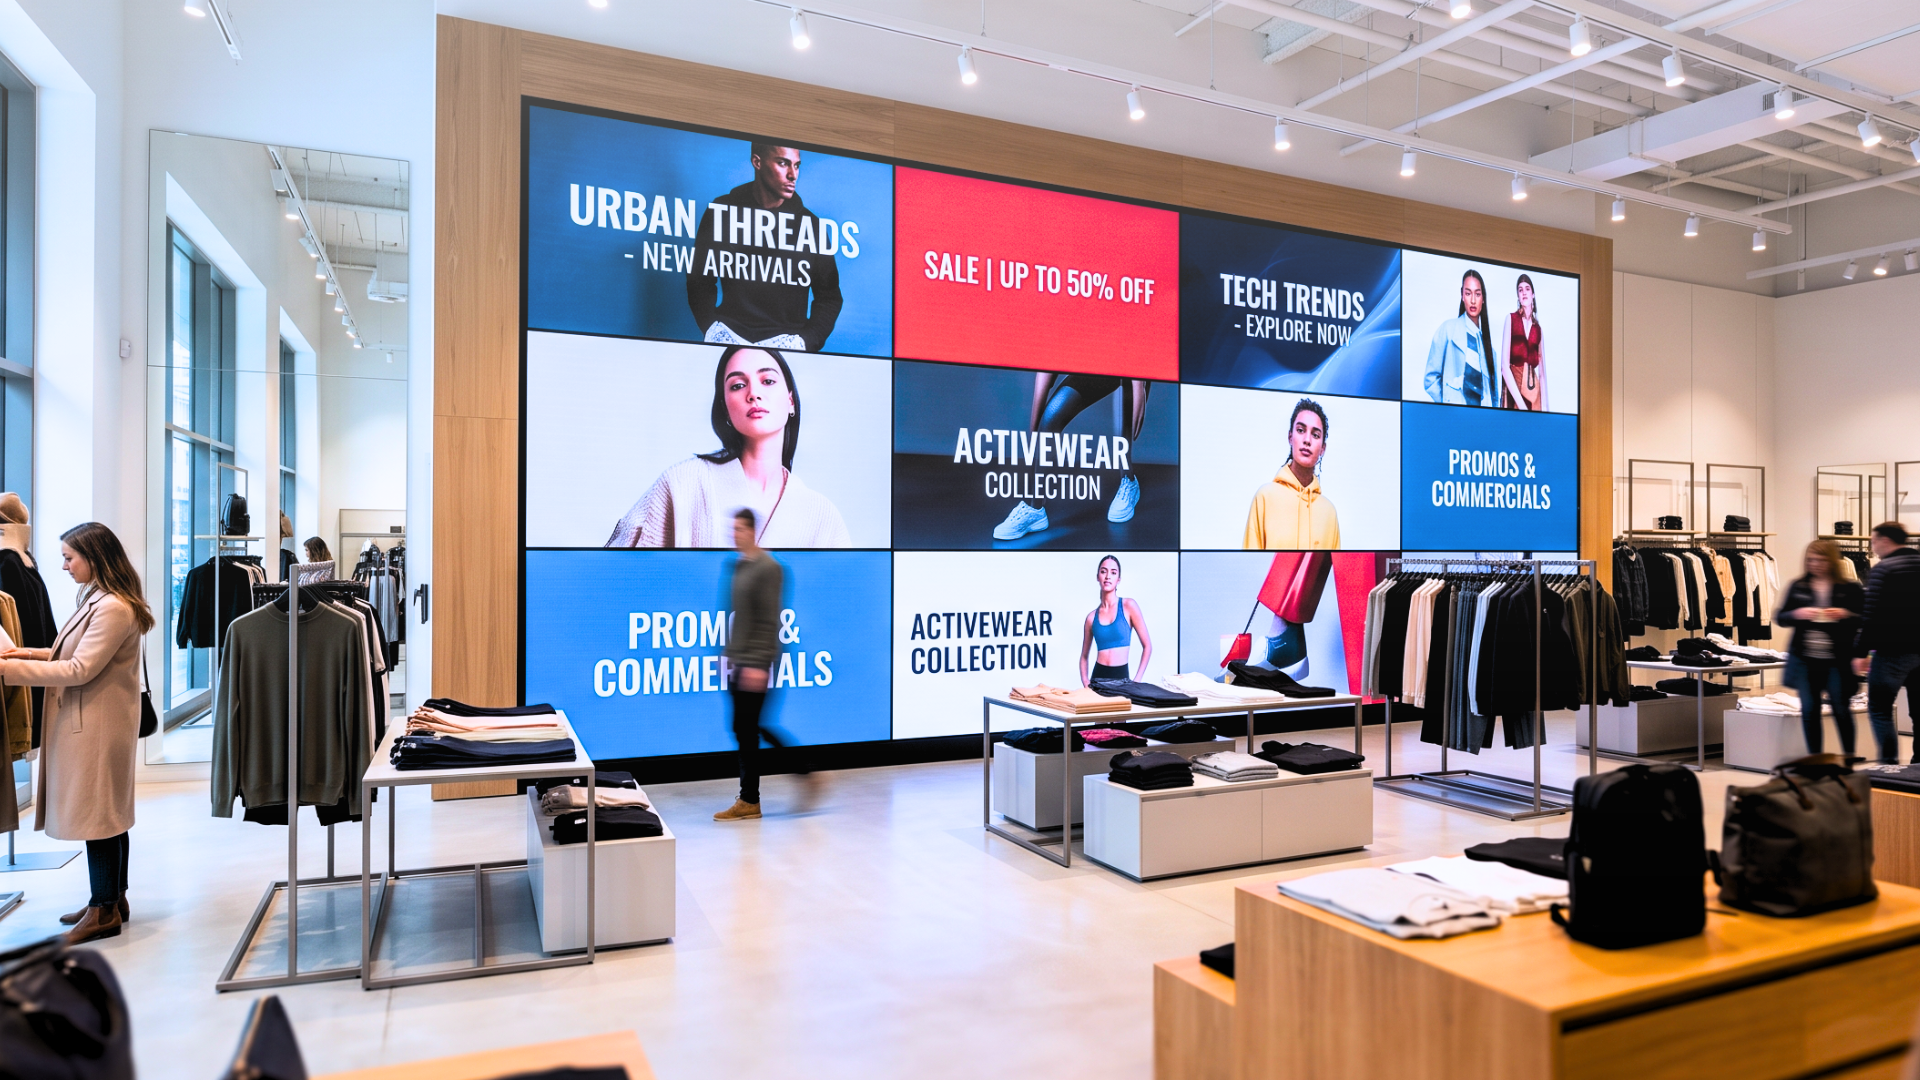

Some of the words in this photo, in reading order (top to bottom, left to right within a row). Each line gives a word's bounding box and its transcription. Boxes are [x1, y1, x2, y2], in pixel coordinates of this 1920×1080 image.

[570, 183, 696, 239] URBAN
[709, 202, 860, 259] THREADS
[643, 240, 695, 274] NEW
[703, 249, 811, 287] ARRIVALS
[924, 250, 979, 285] SALE
[1000, 260, 1029, 290] UP
[1035, 264, 1061, 295] TO
[1067, 269, 1114, 301] 50%
[1120, 276, 1155, 305] OFF
[1220, 273, 1277, 311] TECH
[1284, 282, 1365, 321] TRENDS
[1246, 314, 1313, 344] EXPLORE
[1317, 321, 1352, 347] NOW
[953, 427, 1130, 471] ACTIVEWEAR
[1449, 448, 1520, 477] PROMOS
[1524, 453, 1536, 478] &
[985, 471, 1101, 500] COLLECTION
[1431, 480, 1551, 510] COMMERCIALS
[629, 610, 736, 649] PROM
[778, 608, 800, 644] &
[910, 610, 1053, 641] ACTIVEWEAR
[911, 642, 1047, 675] COLLECTION
